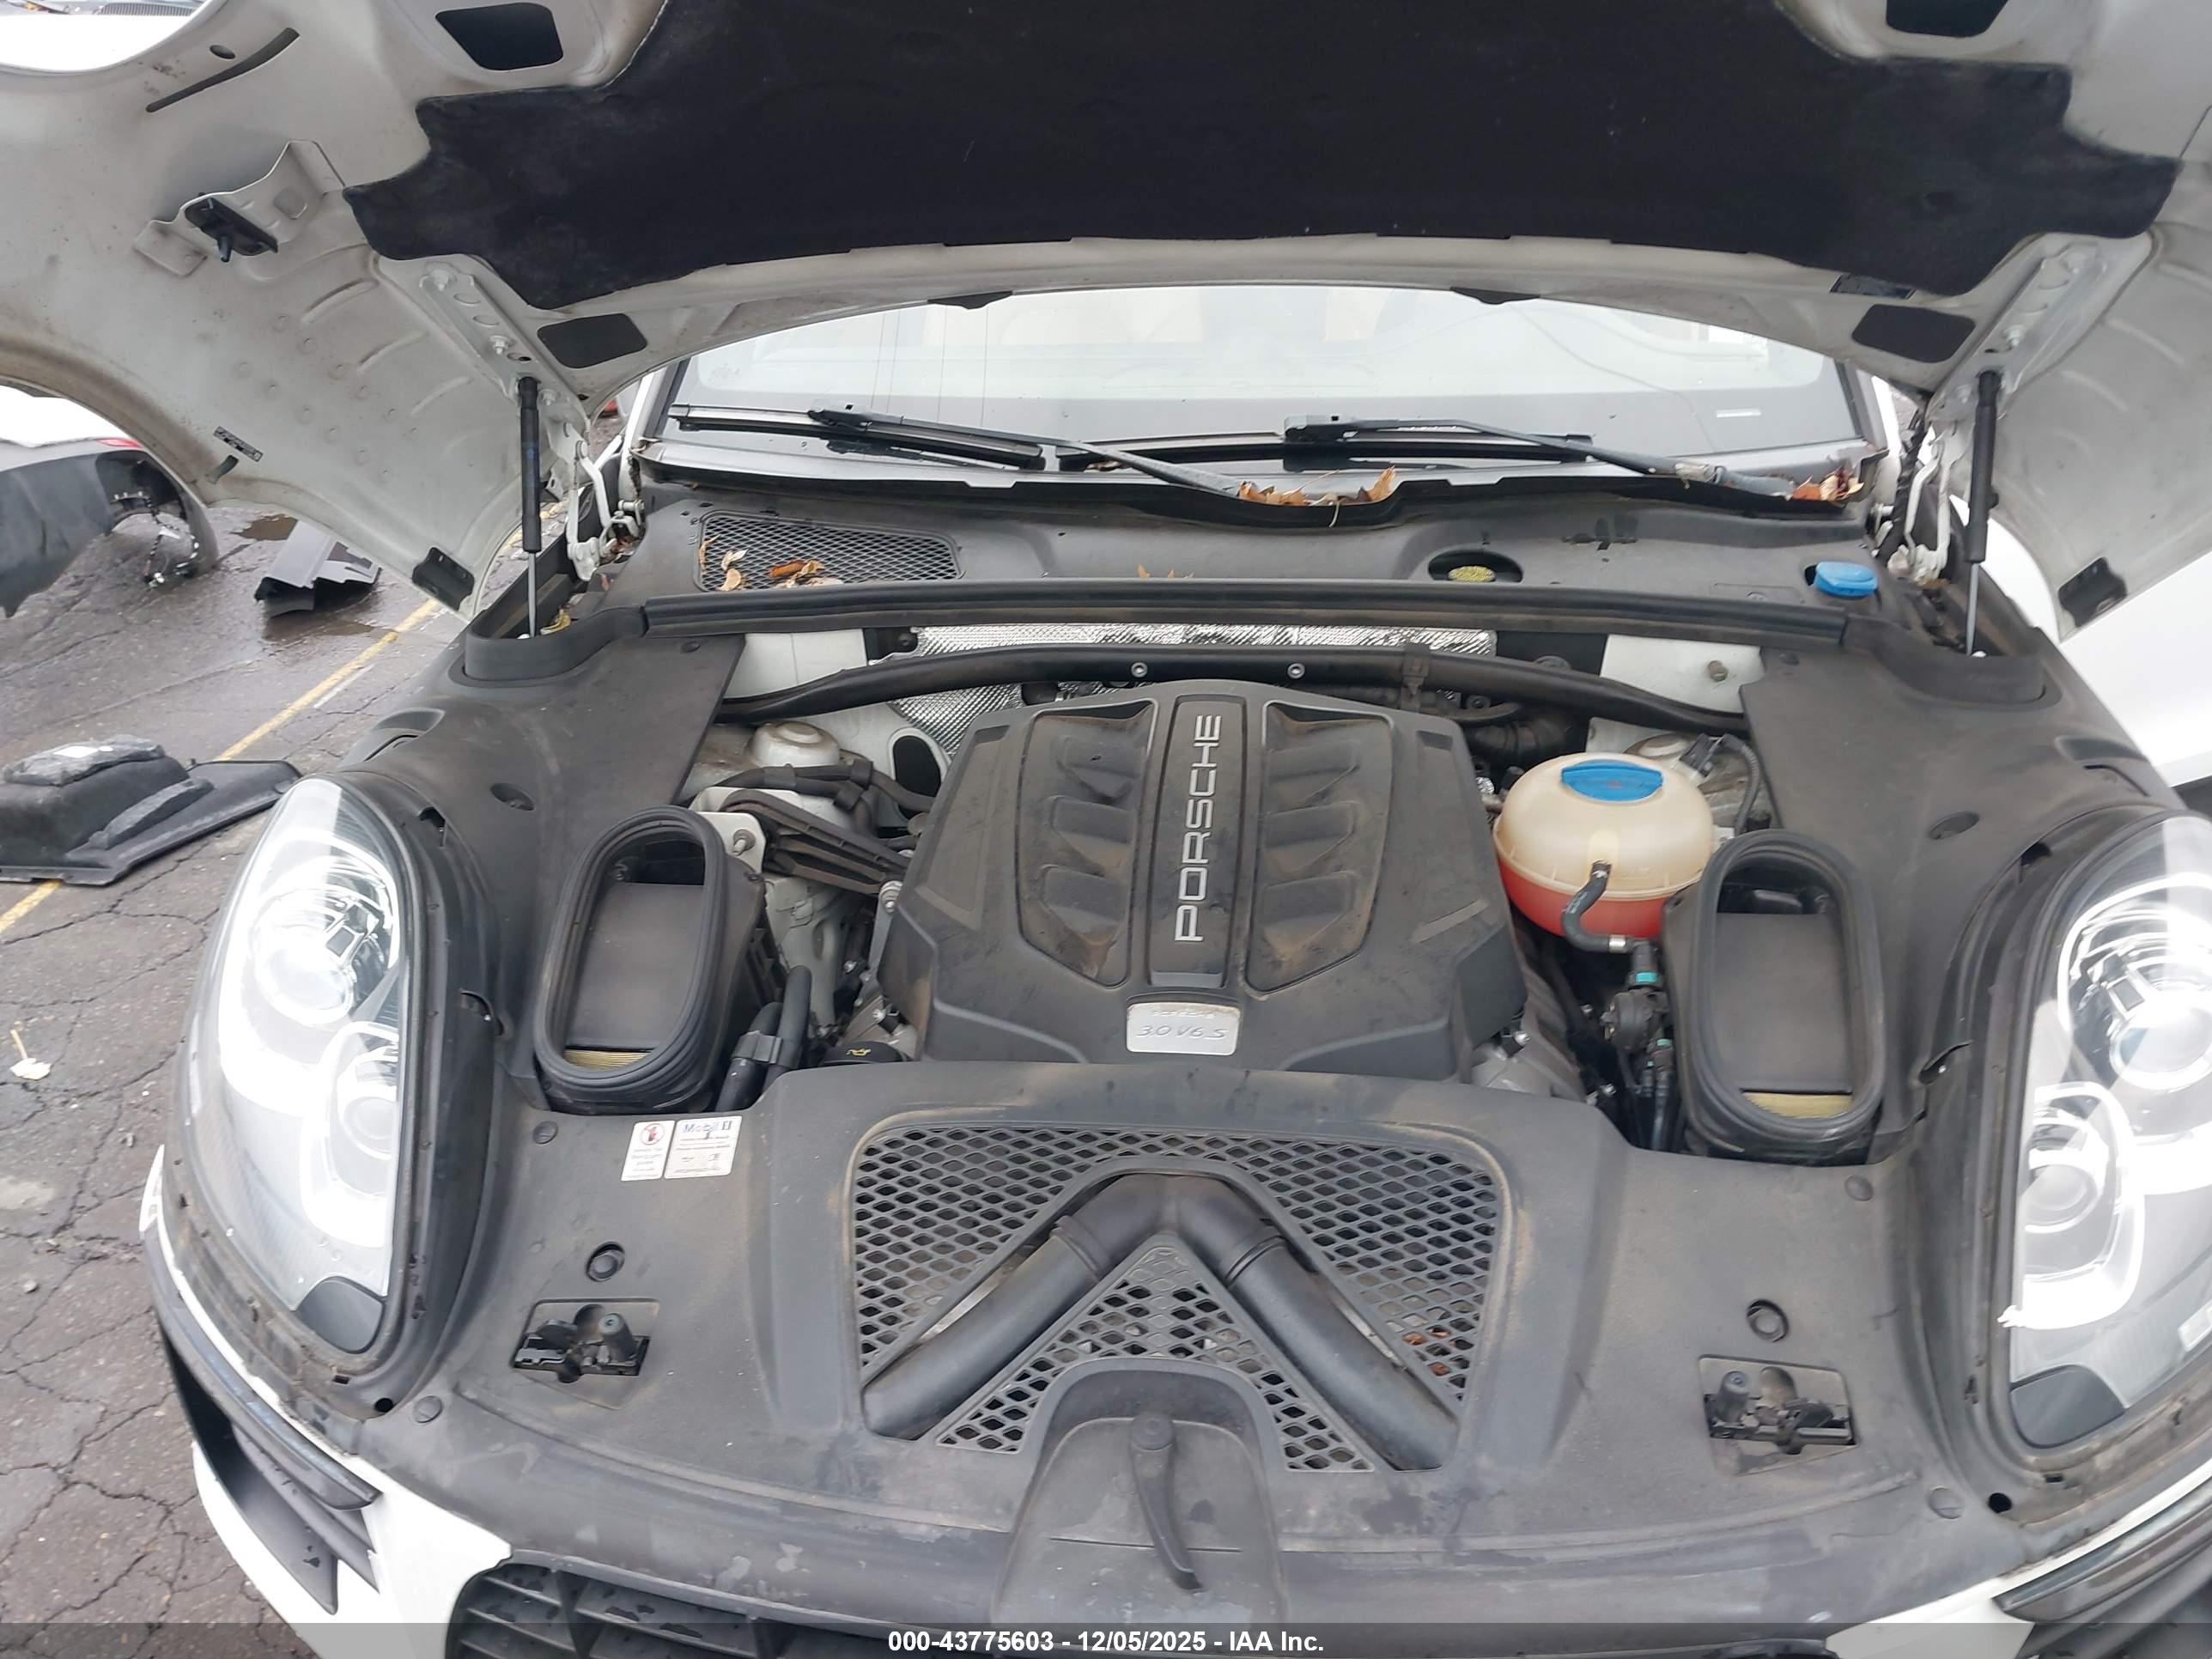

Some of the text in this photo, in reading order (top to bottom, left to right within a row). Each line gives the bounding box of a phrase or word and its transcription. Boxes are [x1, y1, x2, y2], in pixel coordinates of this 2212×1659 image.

[1173, 714, 1223, 942] PORSCHE
[1175, 1024, 1204, 1040] V6
[1203, 1028, 1230, 1041] S
